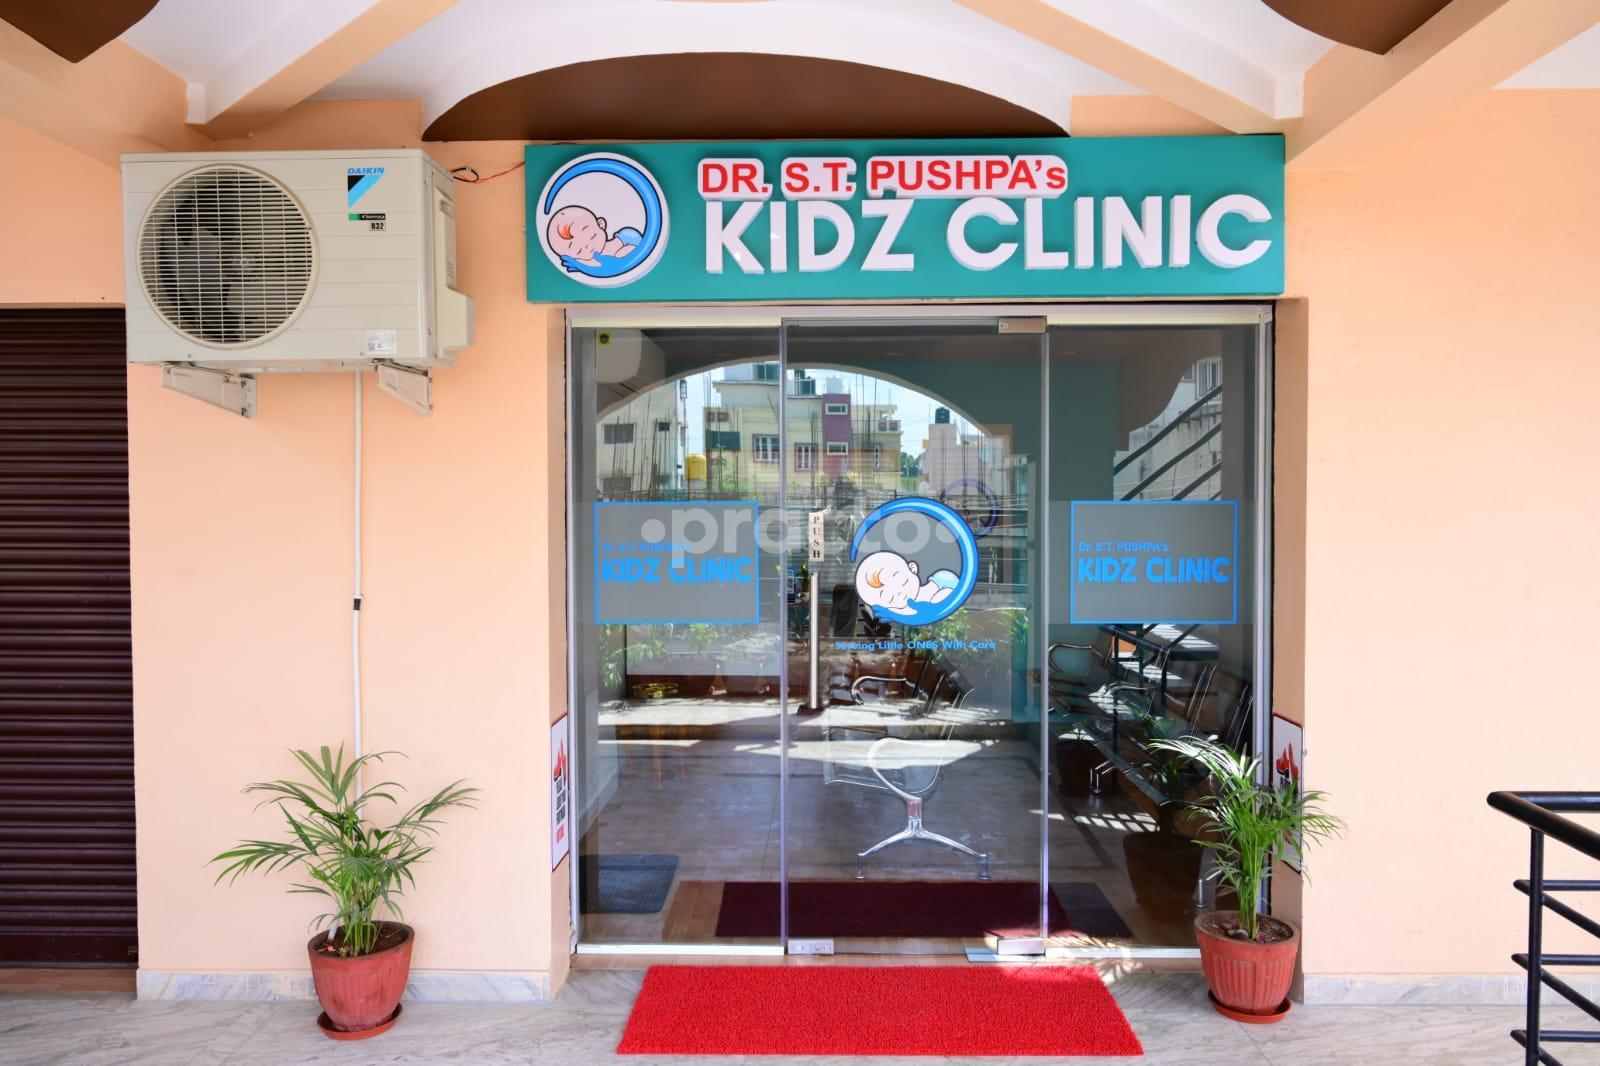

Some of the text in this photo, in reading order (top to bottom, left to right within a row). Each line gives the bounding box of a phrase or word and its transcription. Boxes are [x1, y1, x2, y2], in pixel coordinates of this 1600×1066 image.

[347, 167, 385, 175] DAIKIN
[702, 159, 1067, 193] DR. S.T. PUSHPA's
[371, 222, 385, 230] R32
[705, 194, 1273, 275] KIDZ CLINIC
[813, 515, 821, 559] PUSH
[602, 556, 753, 584] KIDZ CLINIC
[1077, 556, 1231, 584] KIDZ CLINIC
[877, 639, 904, 650] Little
[906, 639, 938, 650] ONES
[941, 639, 967, 650] With
[970, 639, 996, 650] Care
